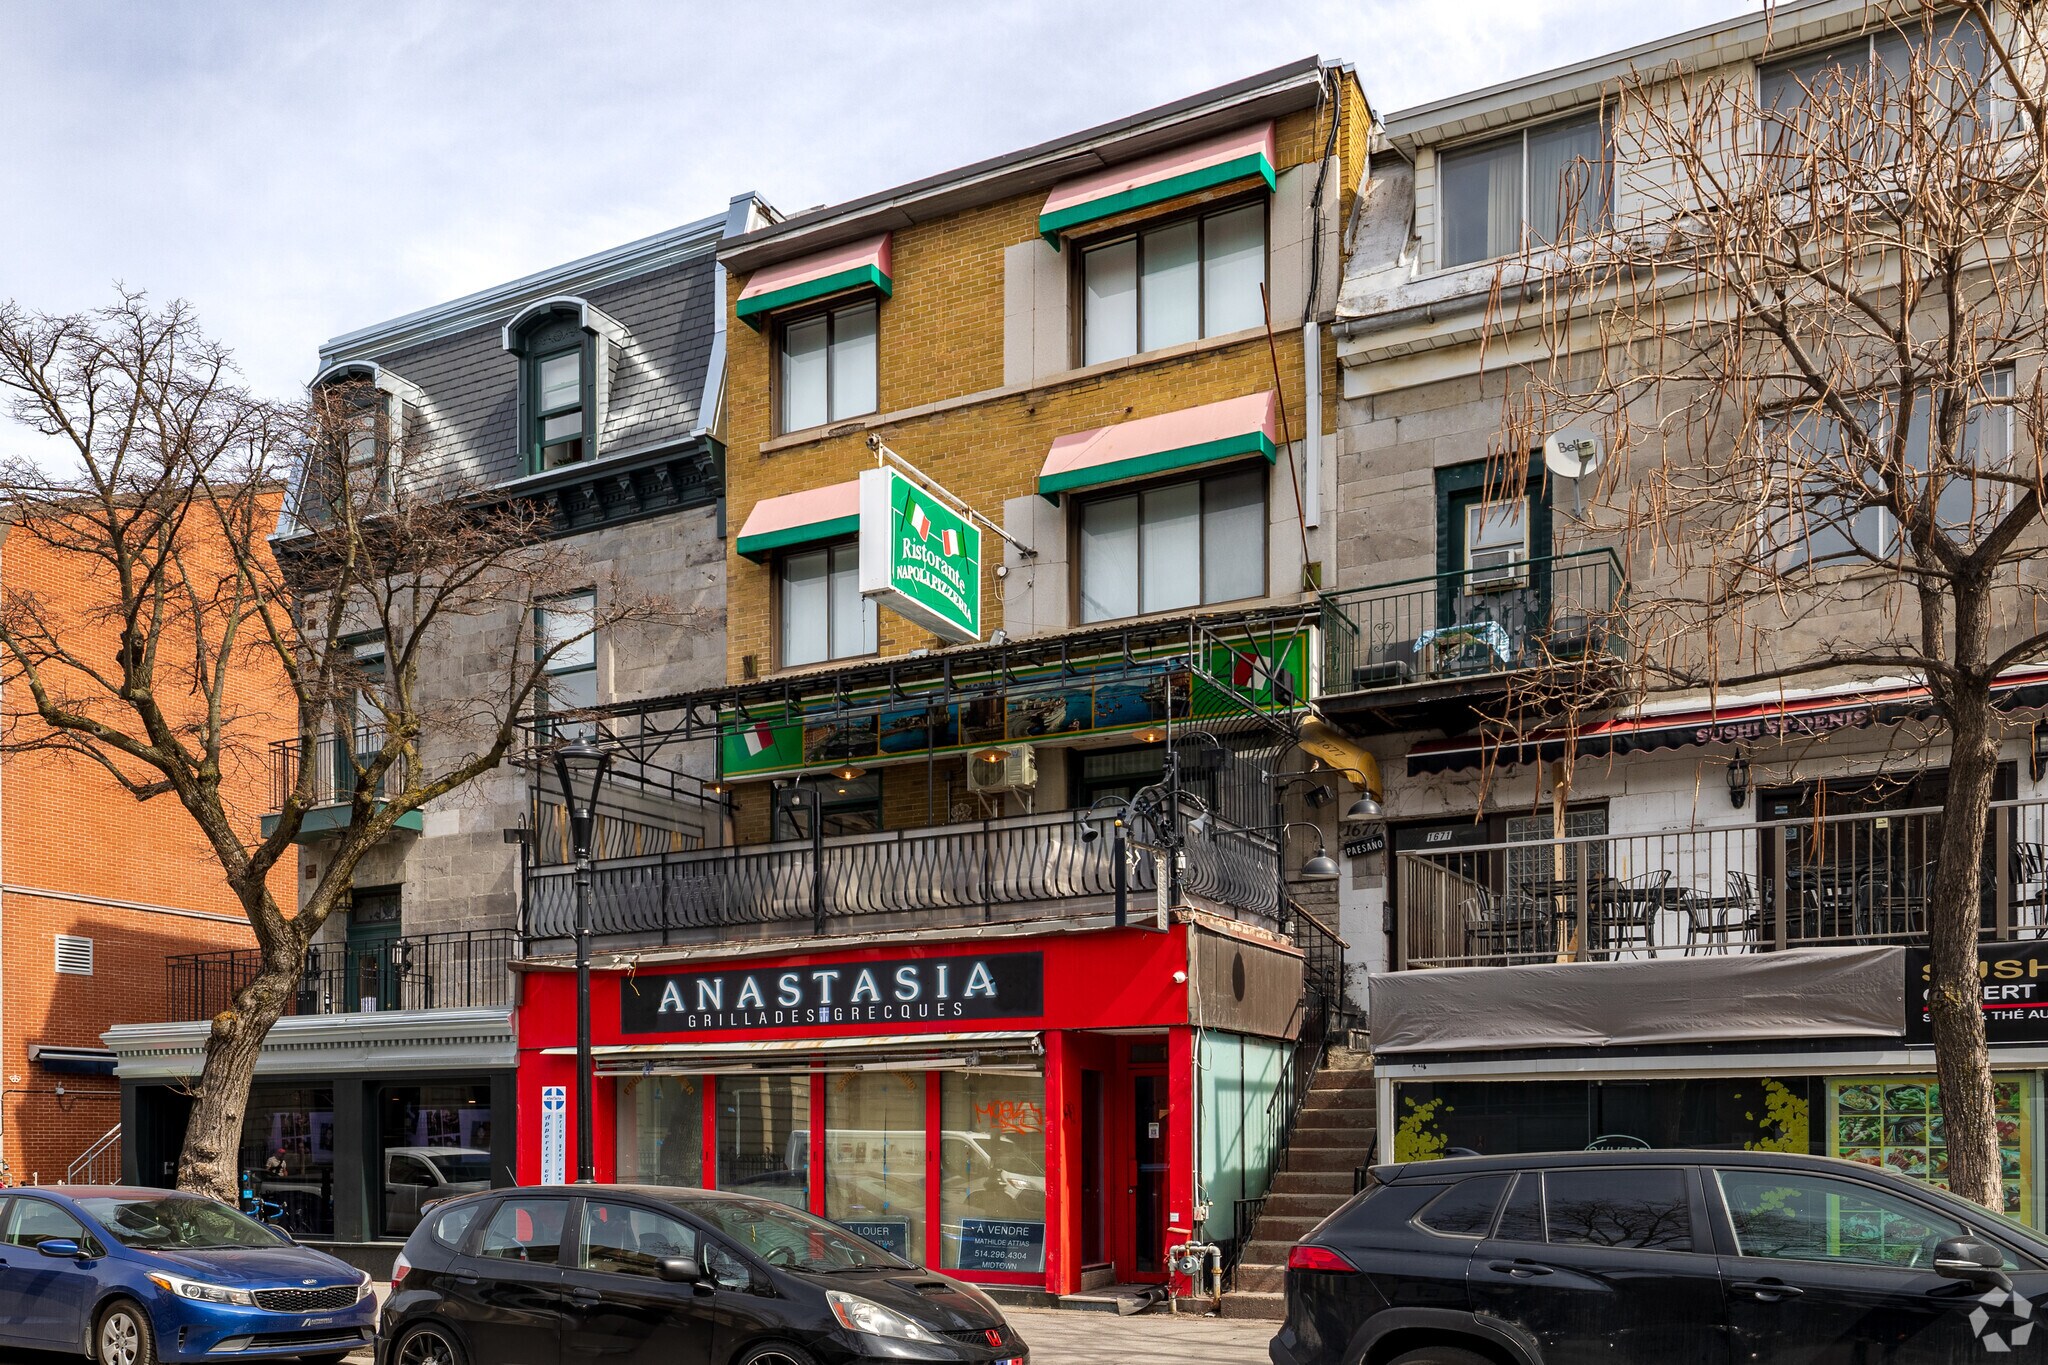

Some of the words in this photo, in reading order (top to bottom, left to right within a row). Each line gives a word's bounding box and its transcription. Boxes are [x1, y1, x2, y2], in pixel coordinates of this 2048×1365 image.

[902, 537, 966, 595] Ristorante
[896, 565, 931, 589] NAPOLI
[930, 573, 972, 624] PIZZERIA
[1696, 722, 1761, 743] SUSHI
[1766, 709, 1868, 735] ST-DENIS
[1317, 740, 1346, 757] 1677
[1344, 822, 1381, 837] 1677
[1428, 831, 1452, 842] 1671
[1922, 959, 2048, 981] SH
[658, 961, 997, 1012] ANASTASIA
[688, 1007, 815, 1028] GRILLADES
[834, 1001, 962, 1021] GRECQUES
[1991, 1008, 2024, 1020] THÉ
[857, 1226, 890, 1236] LOUER
[988, 1225, 1030, 1237] VENDRE
[975, 1238, 1006, 1246] MATHILDE
[1008, 1240, 1030, 1248] ATTIAS
[975, 1250, 1027, 1260] 514.296.4304
[982, 1261, 1018, 1270] MIDTOWN
